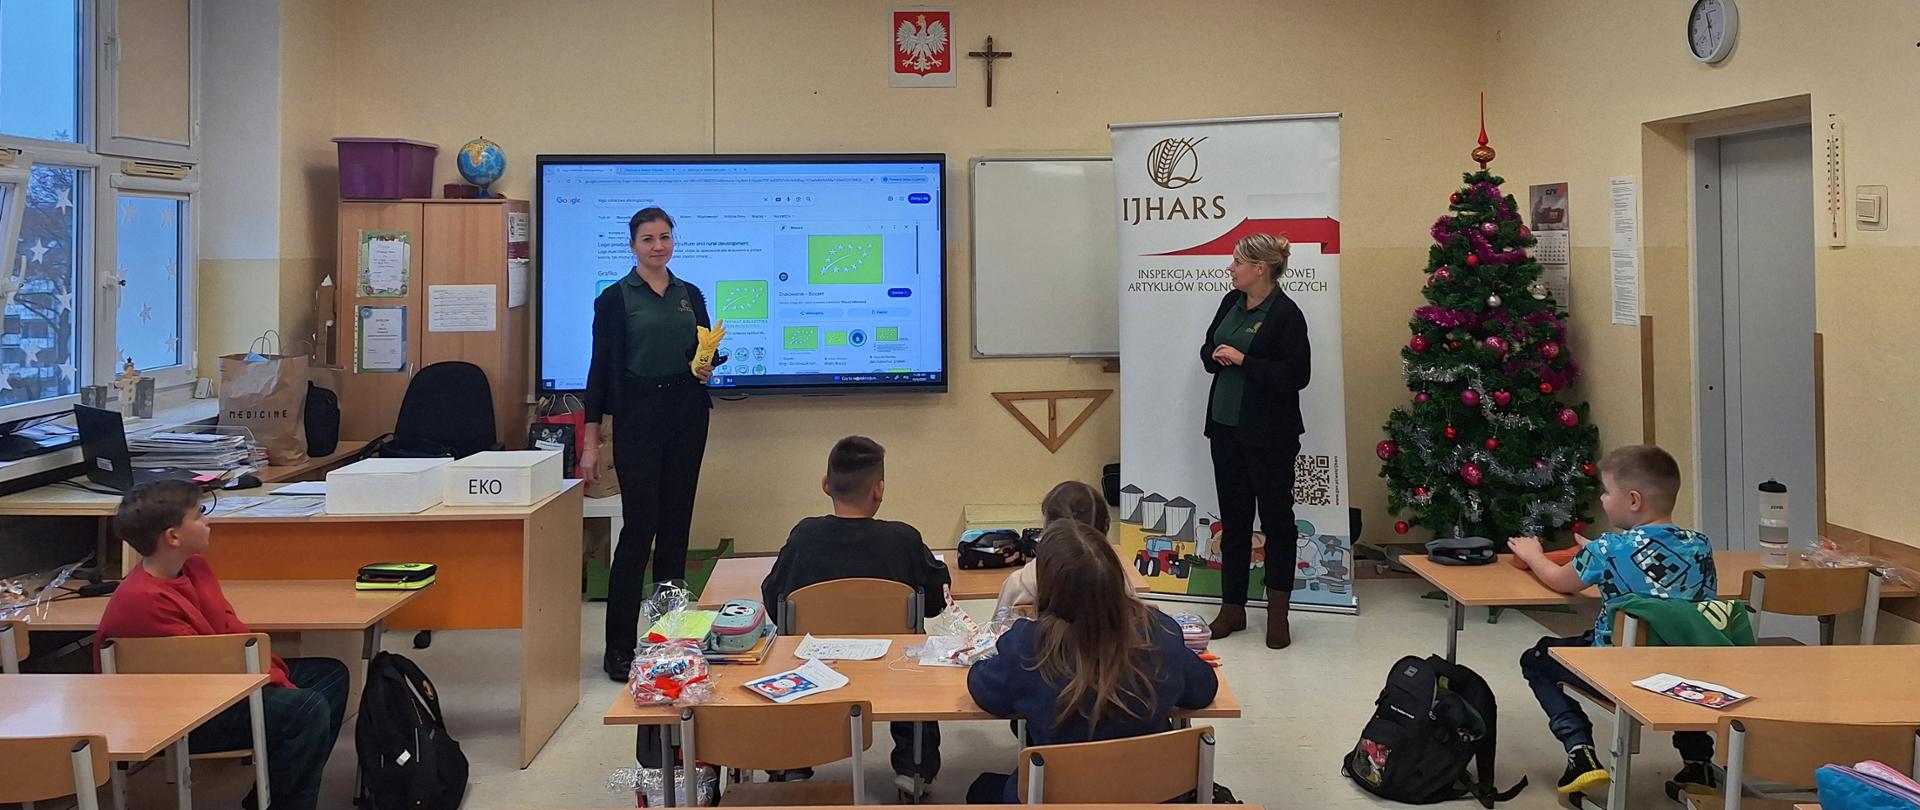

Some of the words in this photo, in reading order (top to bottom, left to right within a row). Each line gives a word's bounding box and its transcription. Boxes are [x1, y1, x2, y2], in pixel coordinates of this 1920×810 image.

[556, 196, 581, 204] Google
[1122, 195, 1227, 226] IJHARS
[1138, 269, 1193, 281] INSPEKCJA
[1127, 280, 1195, 292] ARTYKUŁÓW
[229, 409, 289, 419] MEDICINE
[468, 479, 502, 495] EKO
